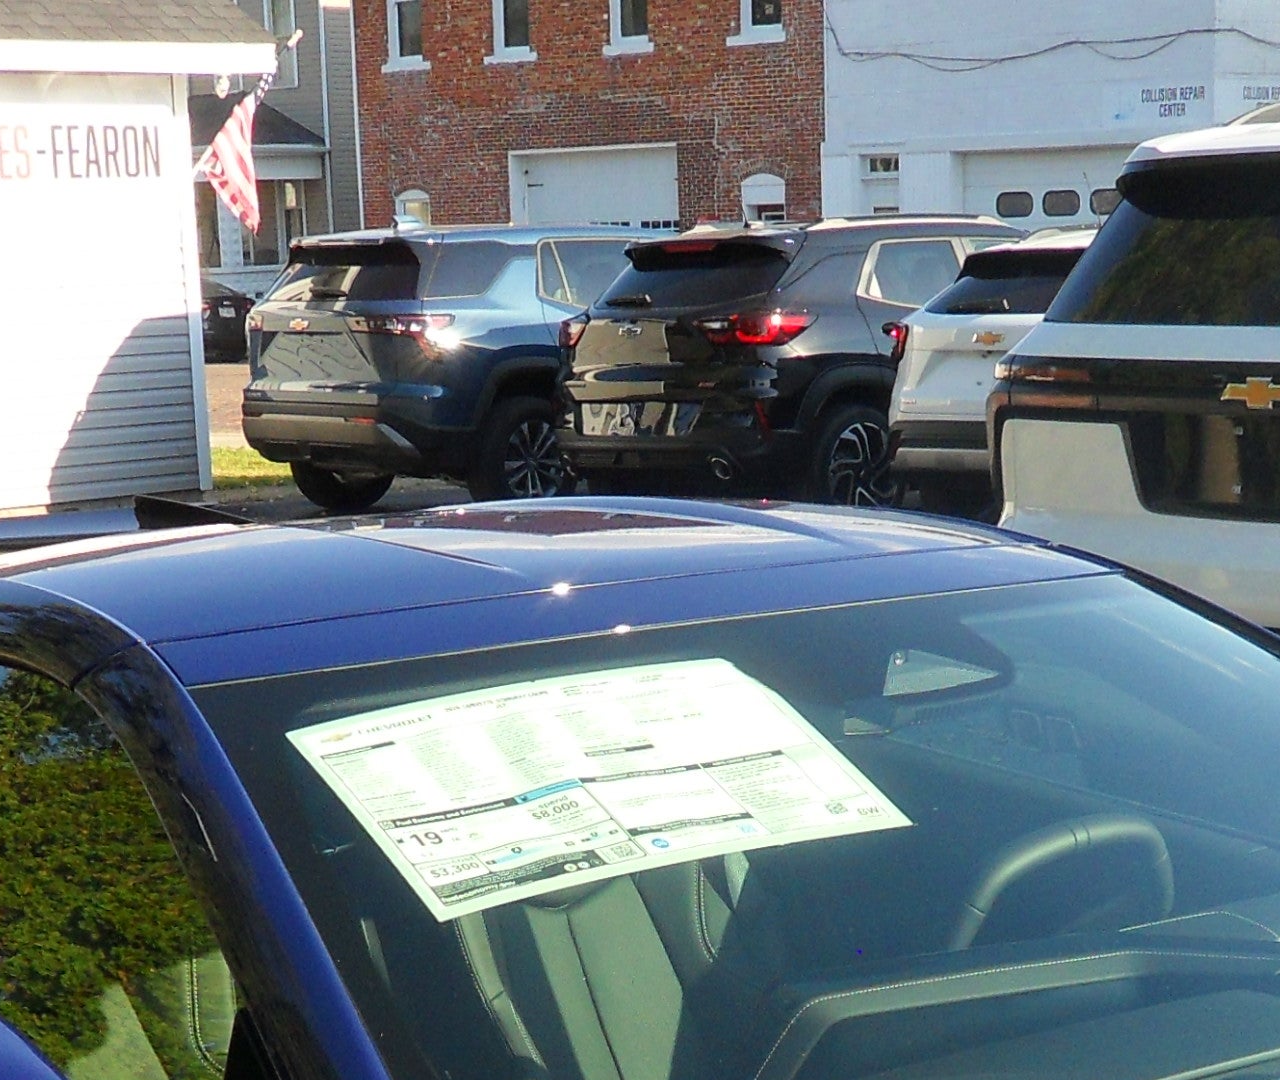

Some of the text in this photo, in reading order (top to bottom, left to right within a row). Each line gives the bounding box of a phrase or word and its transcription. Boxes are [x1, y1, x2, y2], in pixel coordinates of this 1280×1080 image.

[1141, 85, 1206, 103] COLLISION REPAIR
[1158, 102, 1186, 118] CENTER
[409, 831, 444, 847] 19
